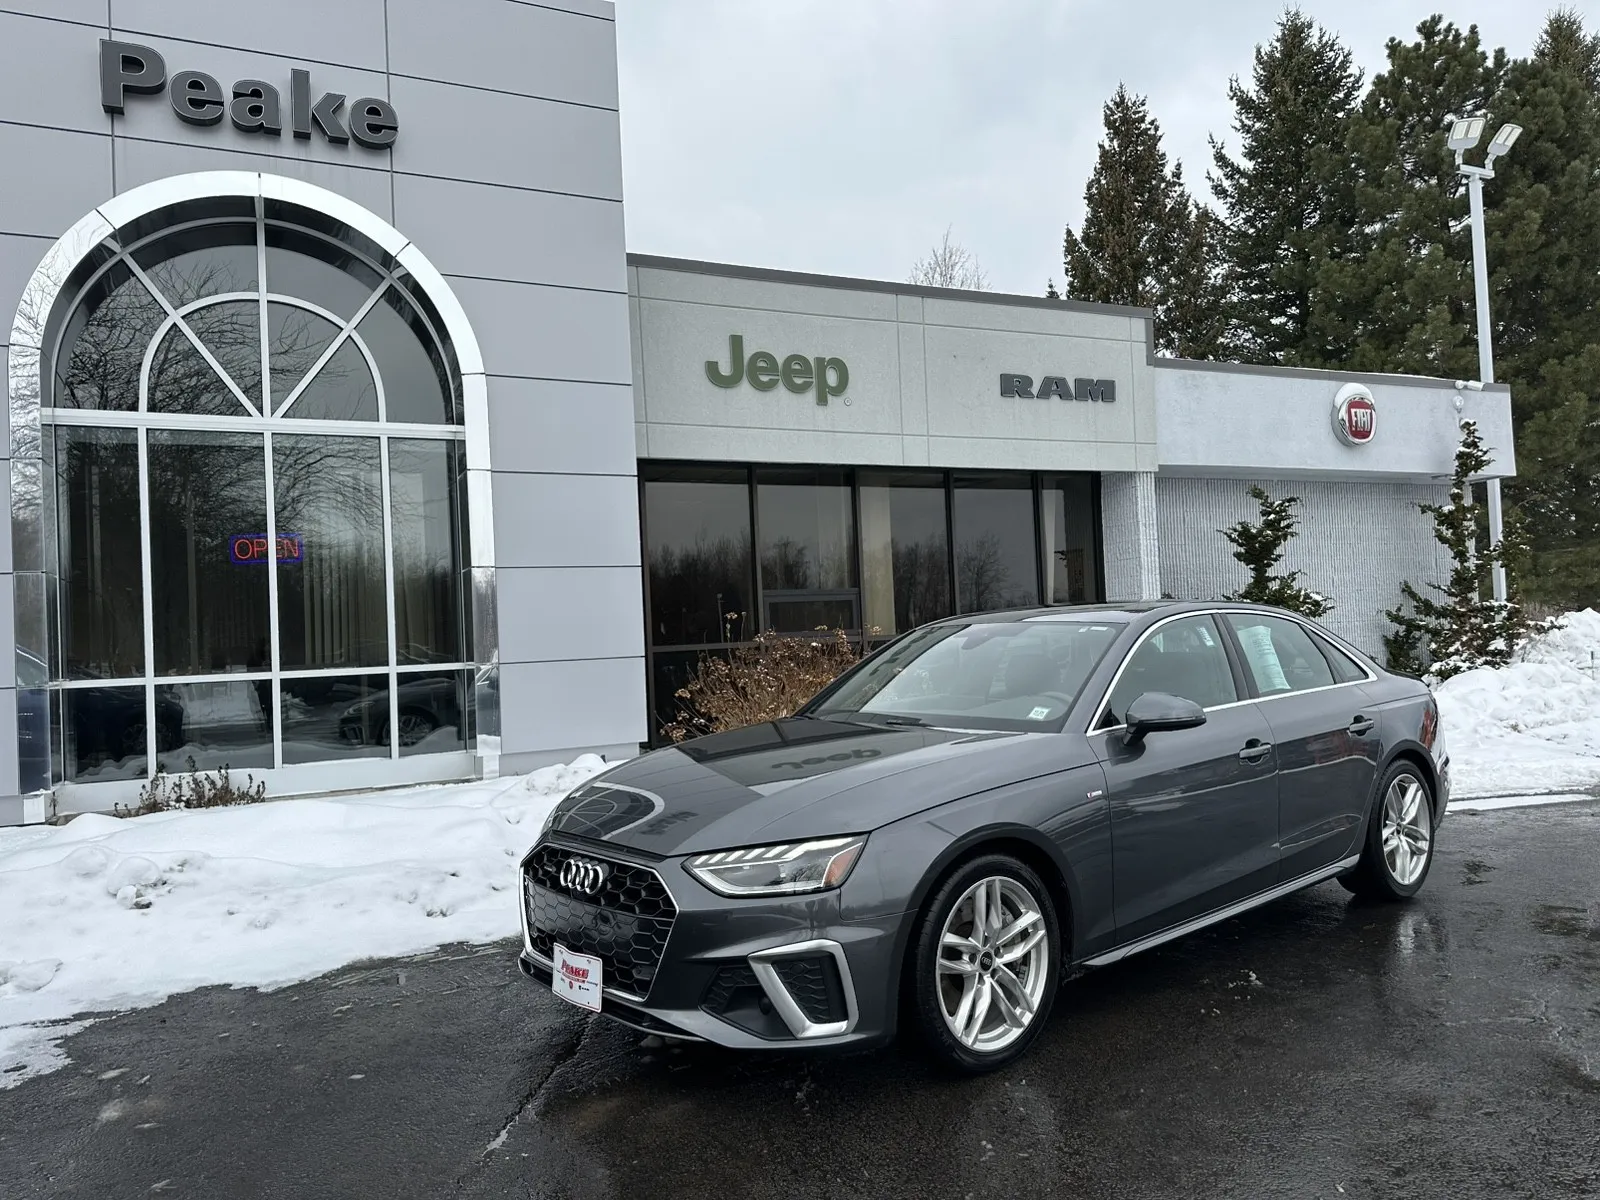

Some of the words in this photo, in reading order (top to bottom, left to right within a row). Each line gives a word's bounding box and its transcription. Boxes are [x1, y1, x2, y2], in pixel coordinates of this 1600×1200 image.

[99, 38, 399, 150] Peake
[704, 334, 849, 406] Jeep
[1000, 373, 1116, 402] RAM
[1350, 408, 1371, 431] FIAT
